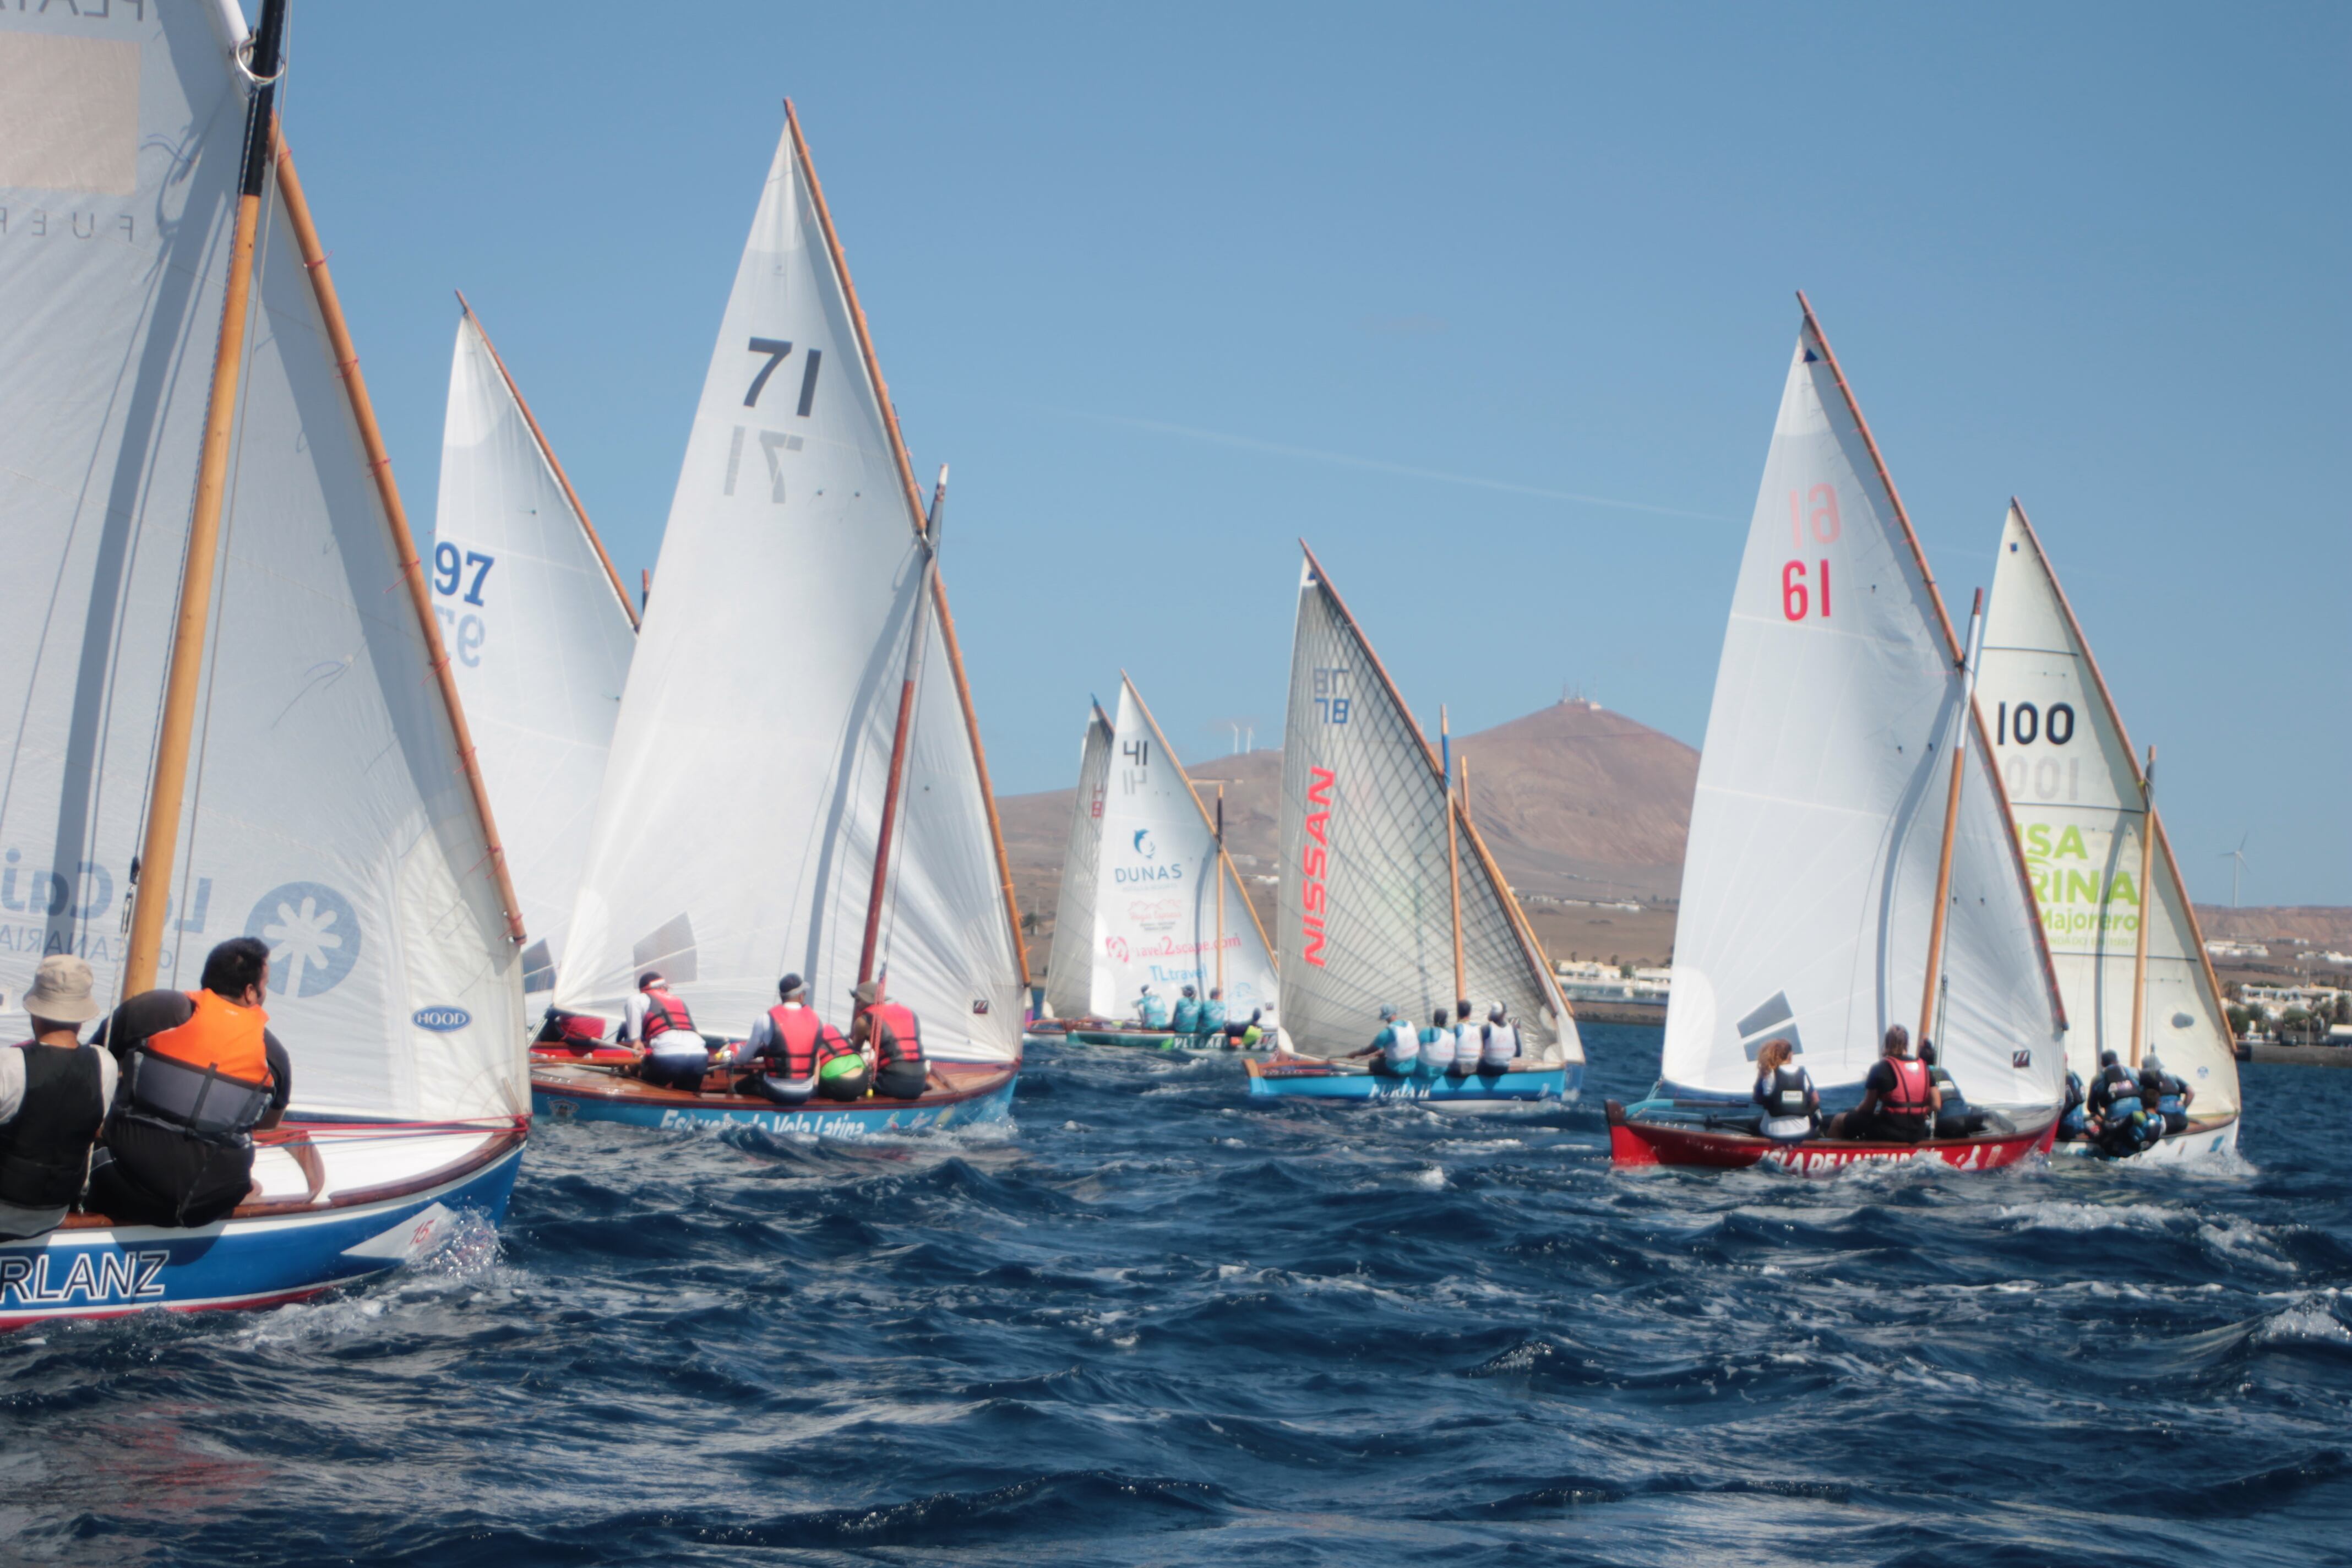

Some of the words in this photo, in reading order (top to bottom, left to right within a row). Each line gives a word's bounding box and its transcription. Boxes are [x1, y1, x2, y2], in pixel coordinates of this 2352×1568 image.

[743, 337, 822, 417] 71
[434, 541, 495, 607] 97
[1782, 559, 1831, 622] 61
[1315, 698, 1349, 723] 78
[1997, 701, 2075, 745] 100
[1123, 740, 1148, 766] 41
[1114, 863, 1183, 883] DUNAS
[1301, 765, 1336, 967] NISSAN
[417, 1012, 467, 1025] HOOD
[409, 1219, 435, 1245] 15
